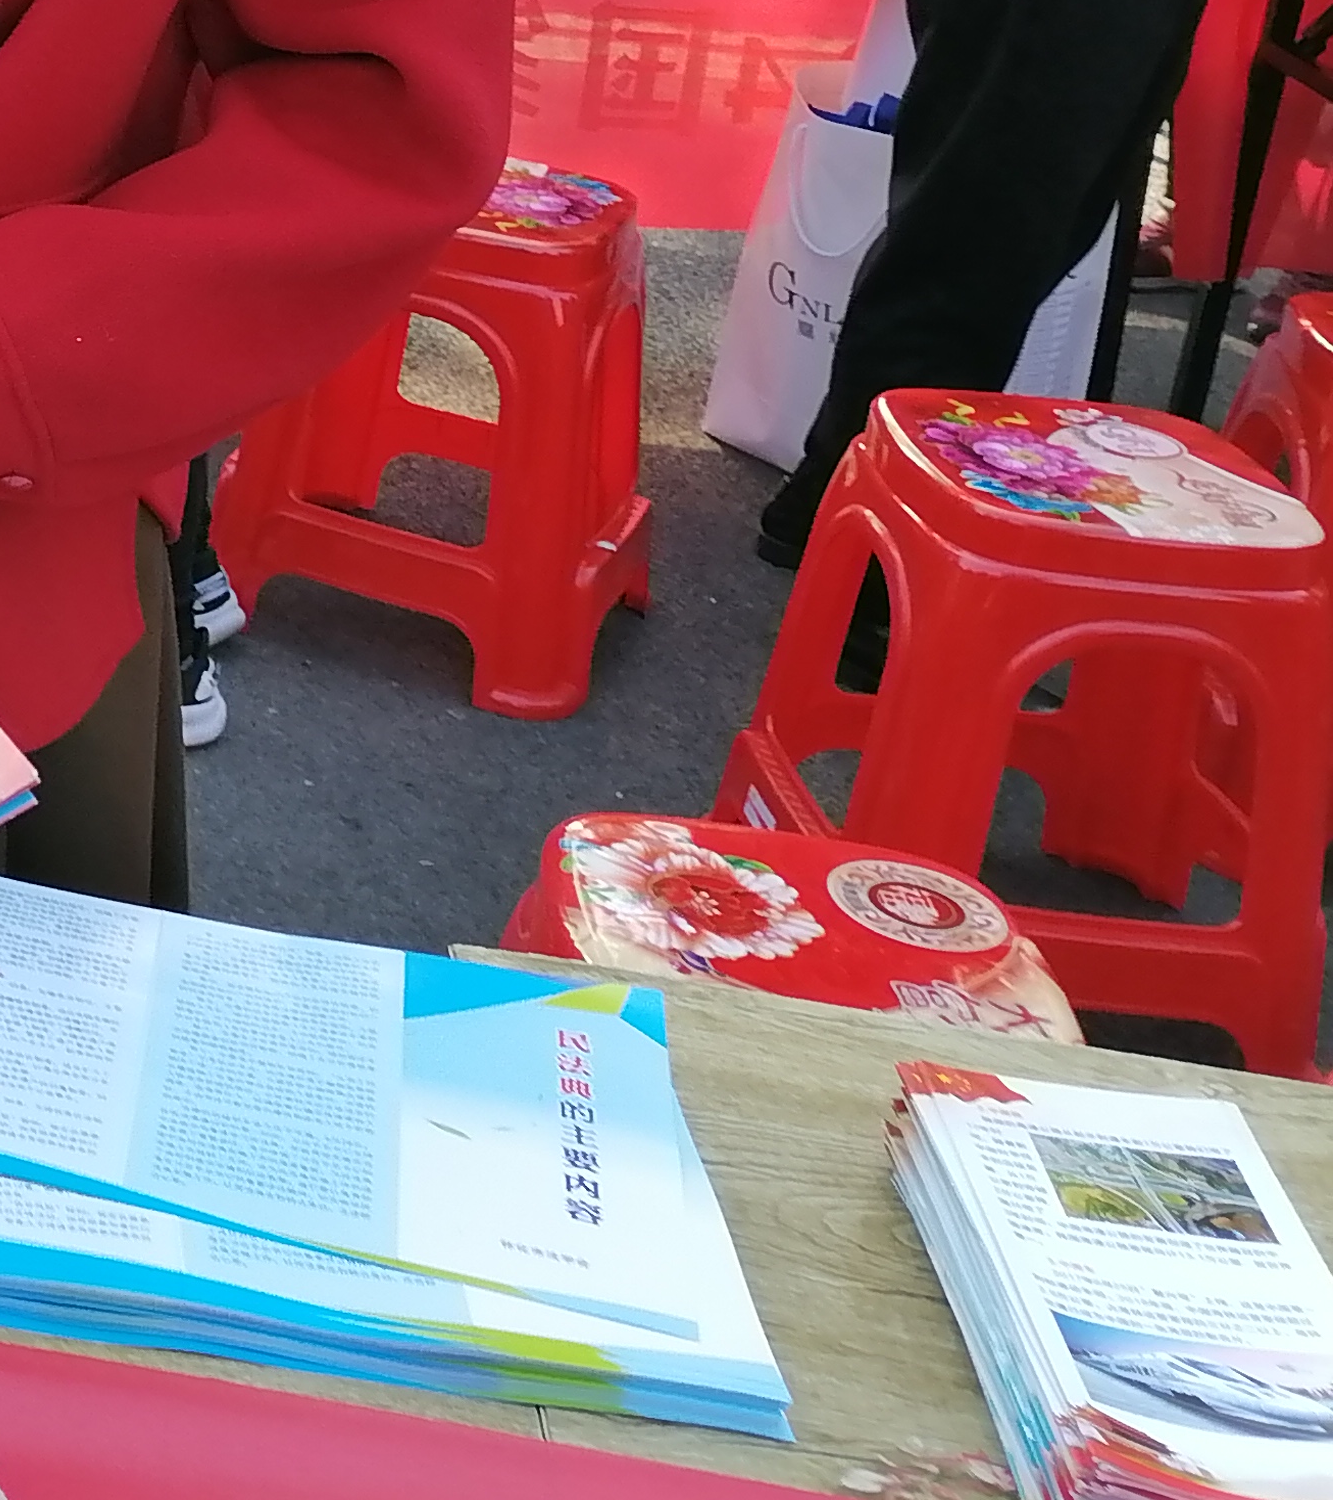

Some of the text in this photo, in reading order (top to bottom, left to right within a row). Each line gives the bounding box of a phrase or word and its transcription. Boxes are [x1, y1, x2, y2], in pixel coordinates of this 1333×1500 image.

[556, 1028, 604, 1228] 民法典的主要内容
